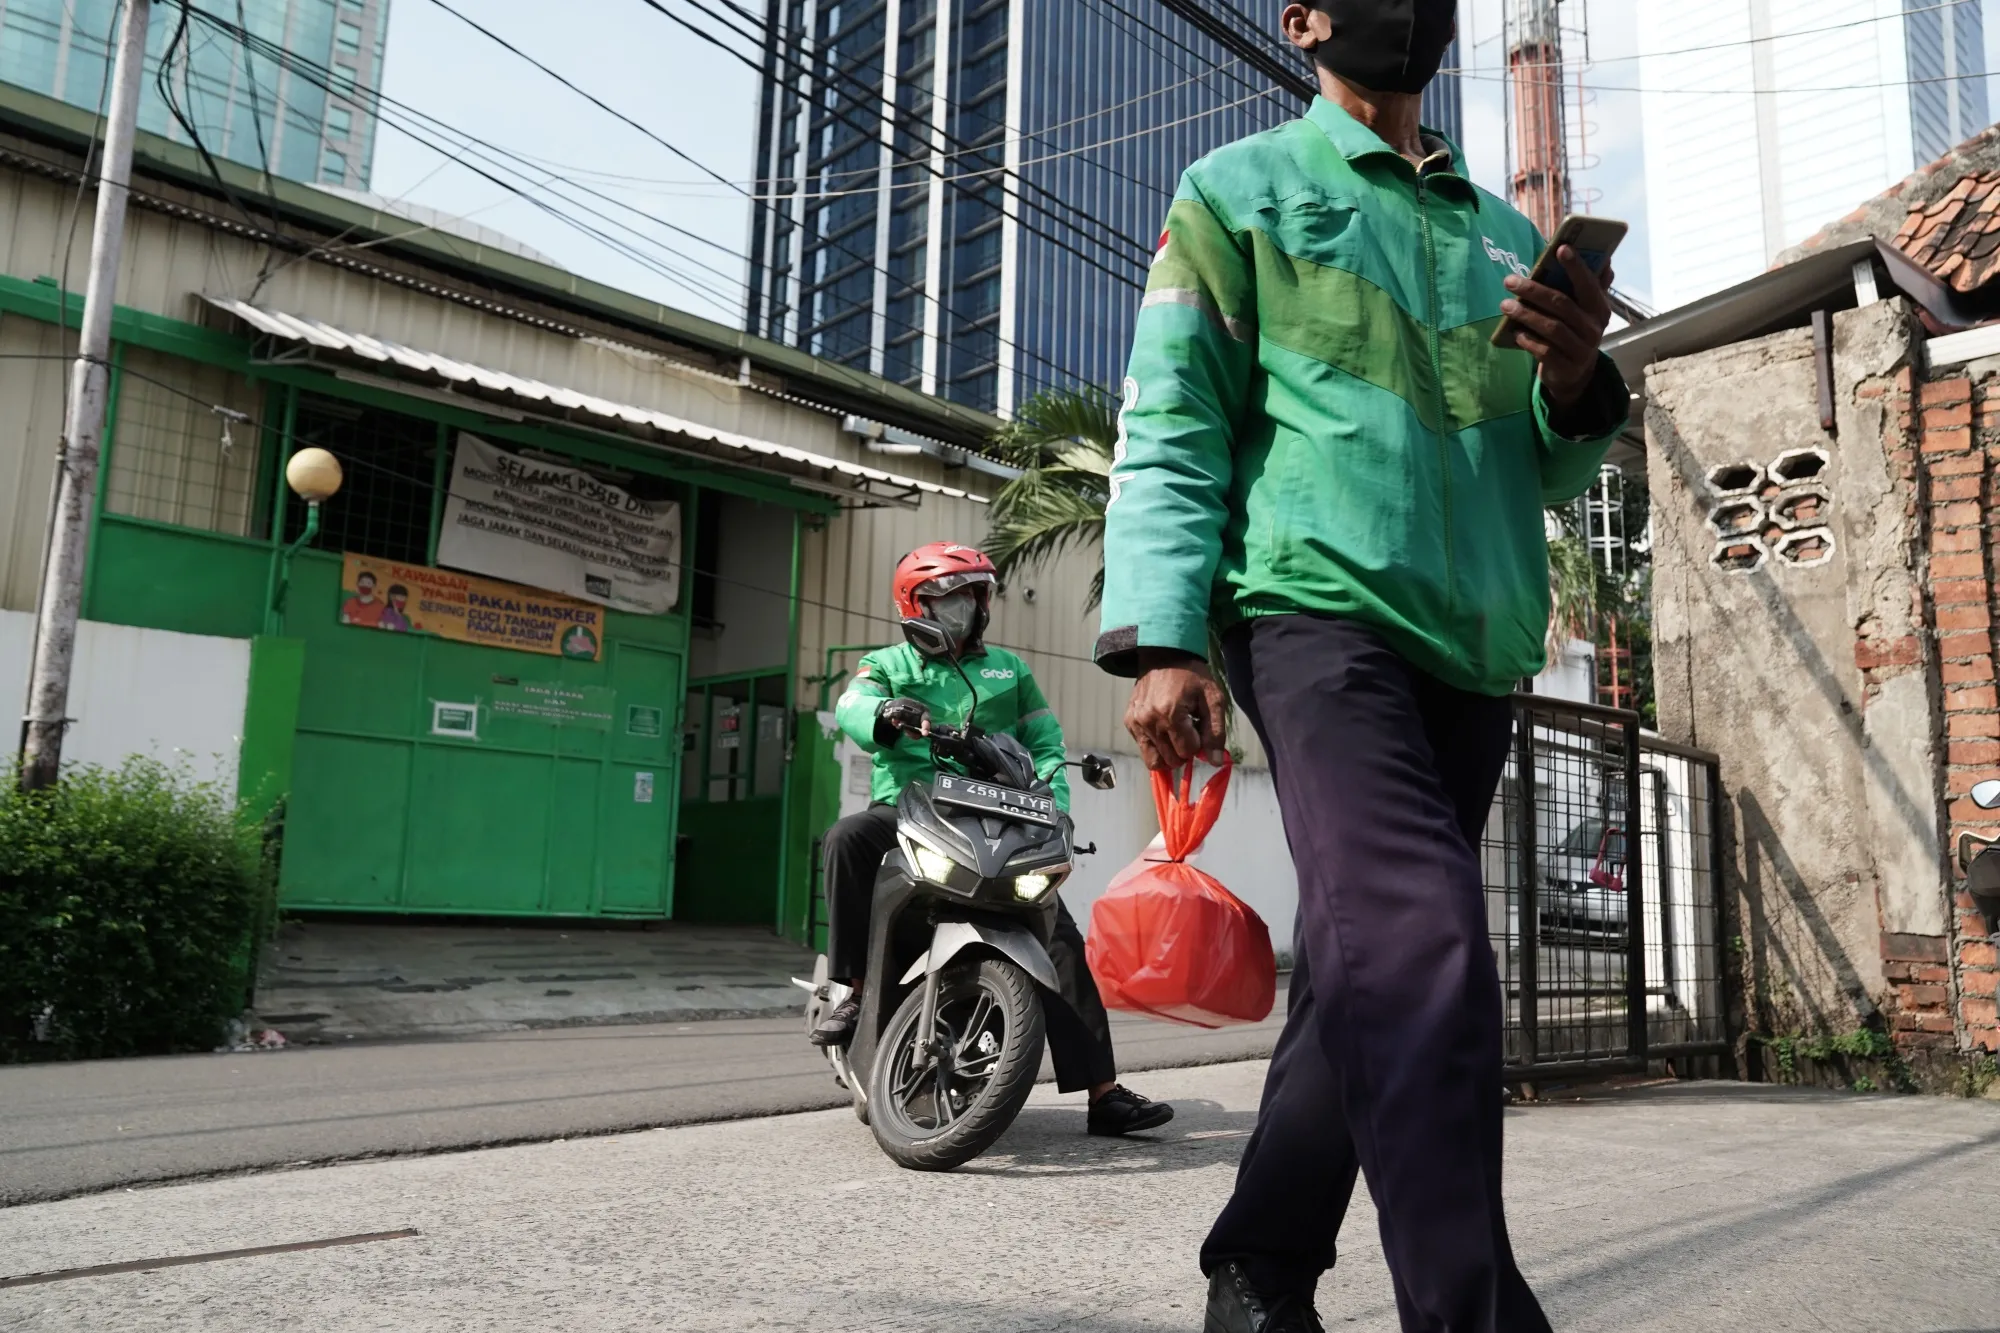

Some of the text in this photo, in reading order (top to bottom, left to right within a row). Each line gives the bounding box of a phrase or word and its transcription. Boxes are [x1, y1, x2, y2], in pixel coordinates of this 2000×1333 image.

[496, 456, 572, 489] SELAMA
[578, 476, 619, 505] PSBB
[578, 501, 601, 515] TIDAK
[457, 513, 485, 527] JAGA
[489, 519, 520, 534] JARAK
[524, 528, 545, 542] DAN
[391, 565, 469, 591] KAWASAN
[420, 600, 556, 631] SERING CUCI TANGAN
[421, 585, 596, 625] WAJIB PAKAI MASKER
[467, 619, 506, 634] PAKAI
[511, 625, 554, 642] SABUN
[980, 668, 1014, 679] Grab
[942, 778, 1050, 811] B 4591 TYF
